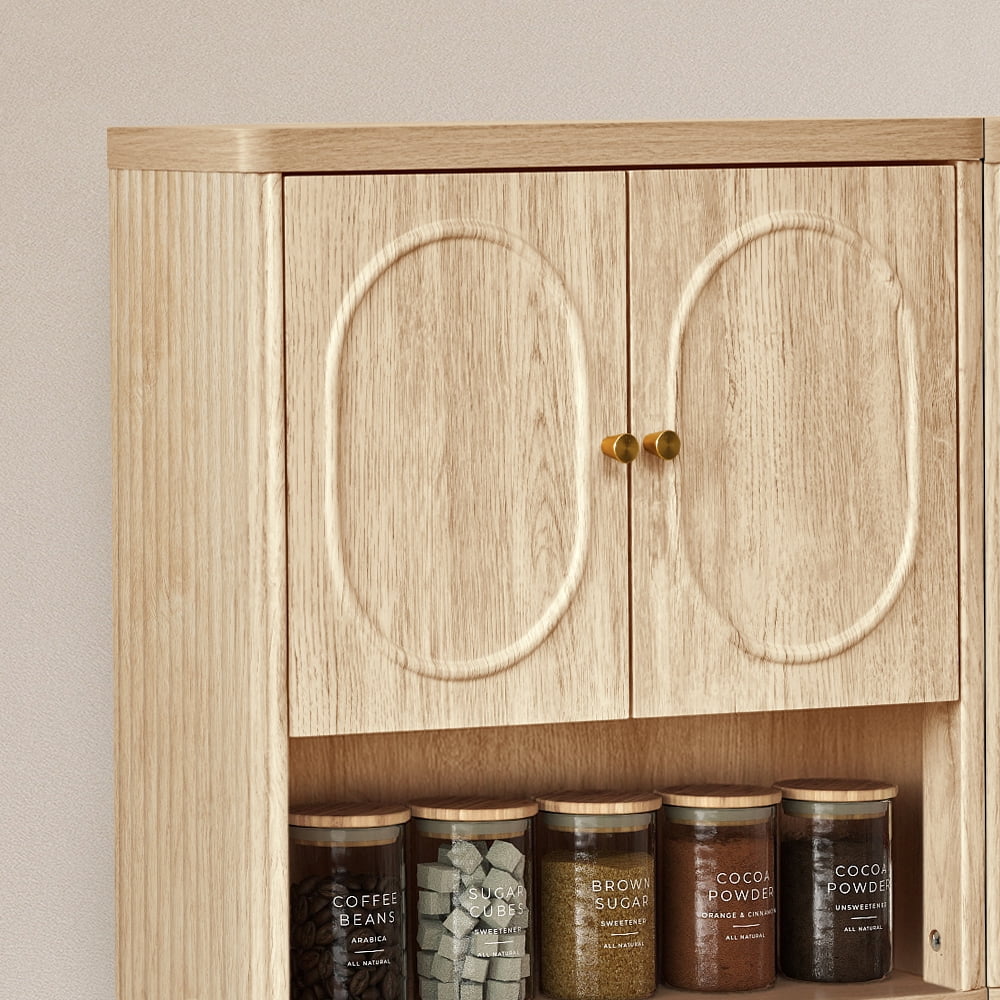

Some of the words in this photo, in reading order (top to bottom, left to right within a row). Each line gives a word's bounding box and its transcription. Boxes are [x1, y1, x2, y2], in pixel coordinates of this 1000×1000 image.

[835, 863, 887, 877] COCOA
[717, 870, 770, 885] COCOA
[592, 878, 650, 892] BROWN
[827, 879, 891, 894] POWDER
[469, 885, 524, 900] SUGAR
[708, 886, 774, 902] POWDER
[333, 892, 397, 908] COFFEE
[595, 895, 649, 910] SUGAR
[470, 903, 524, 918] CUBES
[701, 911, 737, 919] ORANGE
[340, 911, 395, 927] BEANS
[600, 918, 647, 927] SWEETENER
[474, 926, 522, 935] SWEETENER
[351, 935, 387, 944] ARABICA
[618, 941, 644, 949] NATURAL
[362, 959, 391, 967] NATURAL
